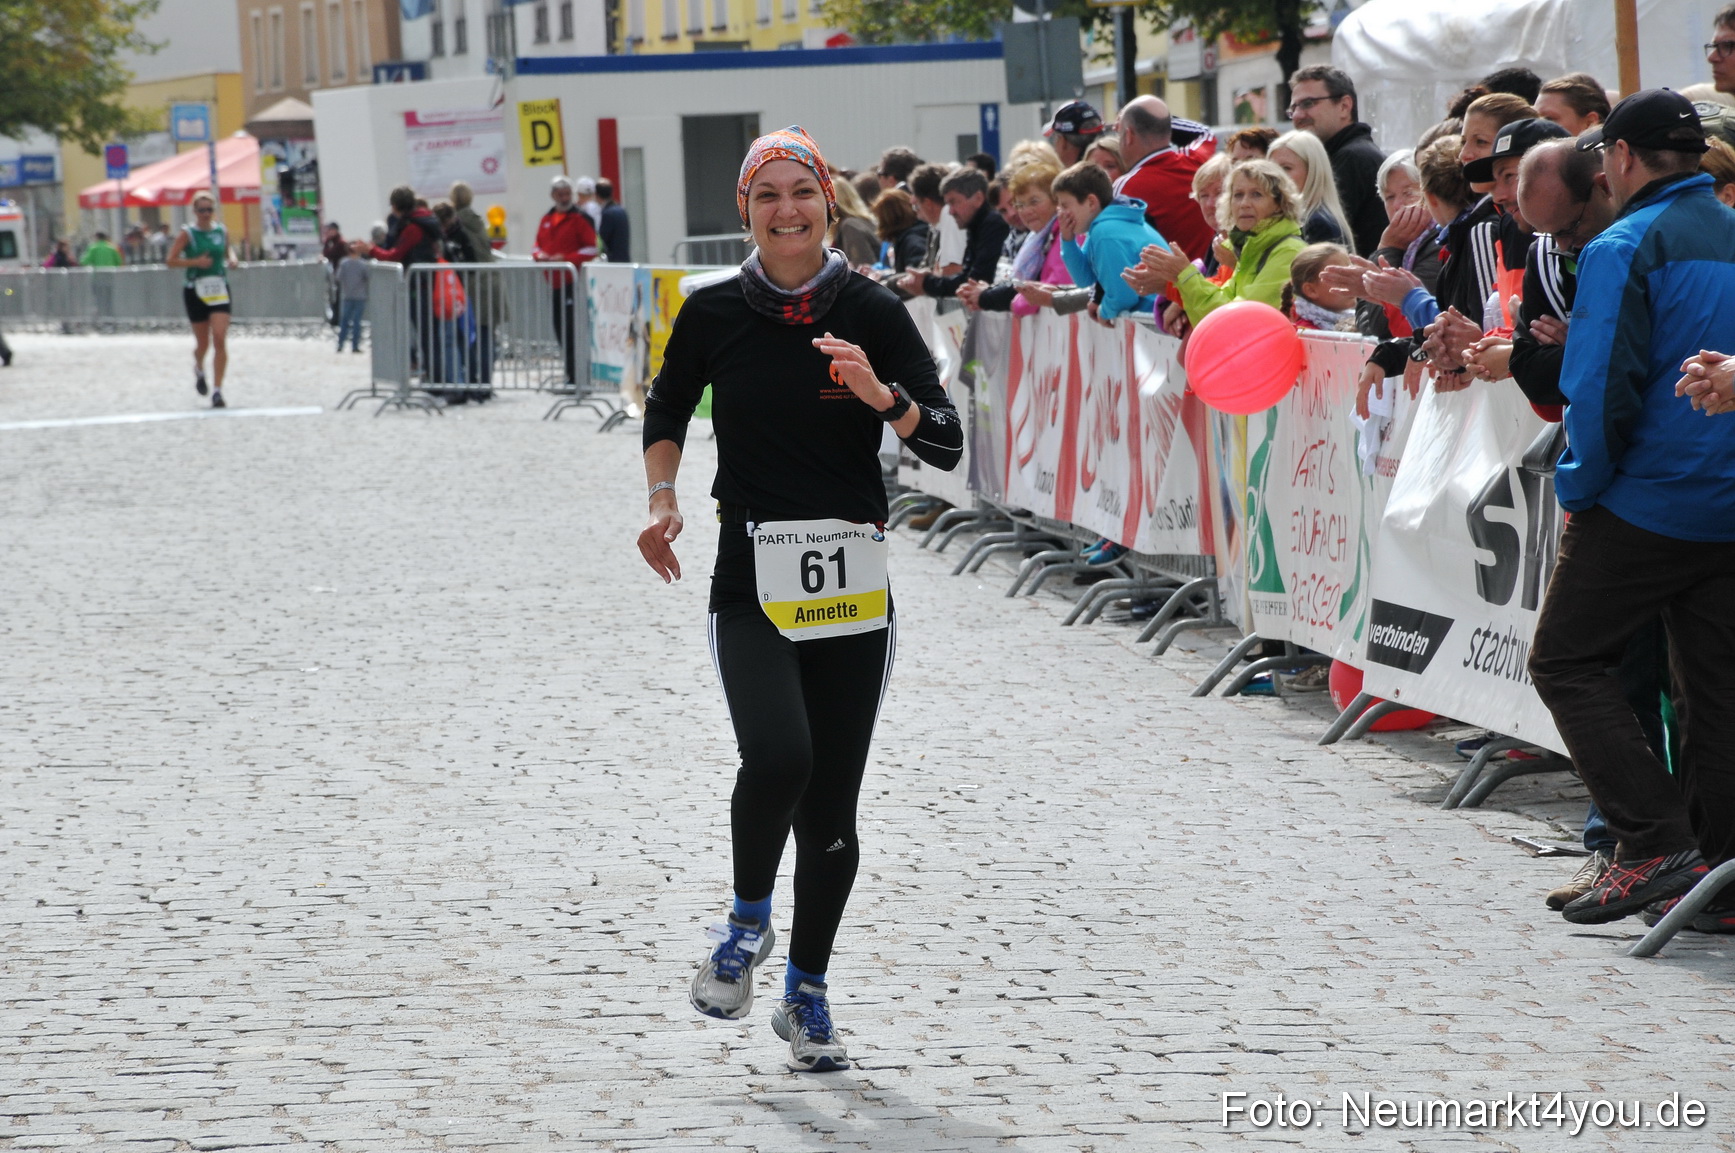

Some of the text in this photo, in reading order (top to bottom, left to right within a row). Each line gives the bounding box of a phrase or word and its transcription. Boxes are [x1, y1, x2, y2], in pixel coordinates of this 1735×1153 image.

[522, 102, 556, 116] Block
[531, 120, 554, 151] D
[758, 530, 866, 546] PARTL Neumarkt
[800, 547, 846, 594] 61
[794, 602, 858, 624] Annette
[1369, 622, 1430, 656] verbinden
